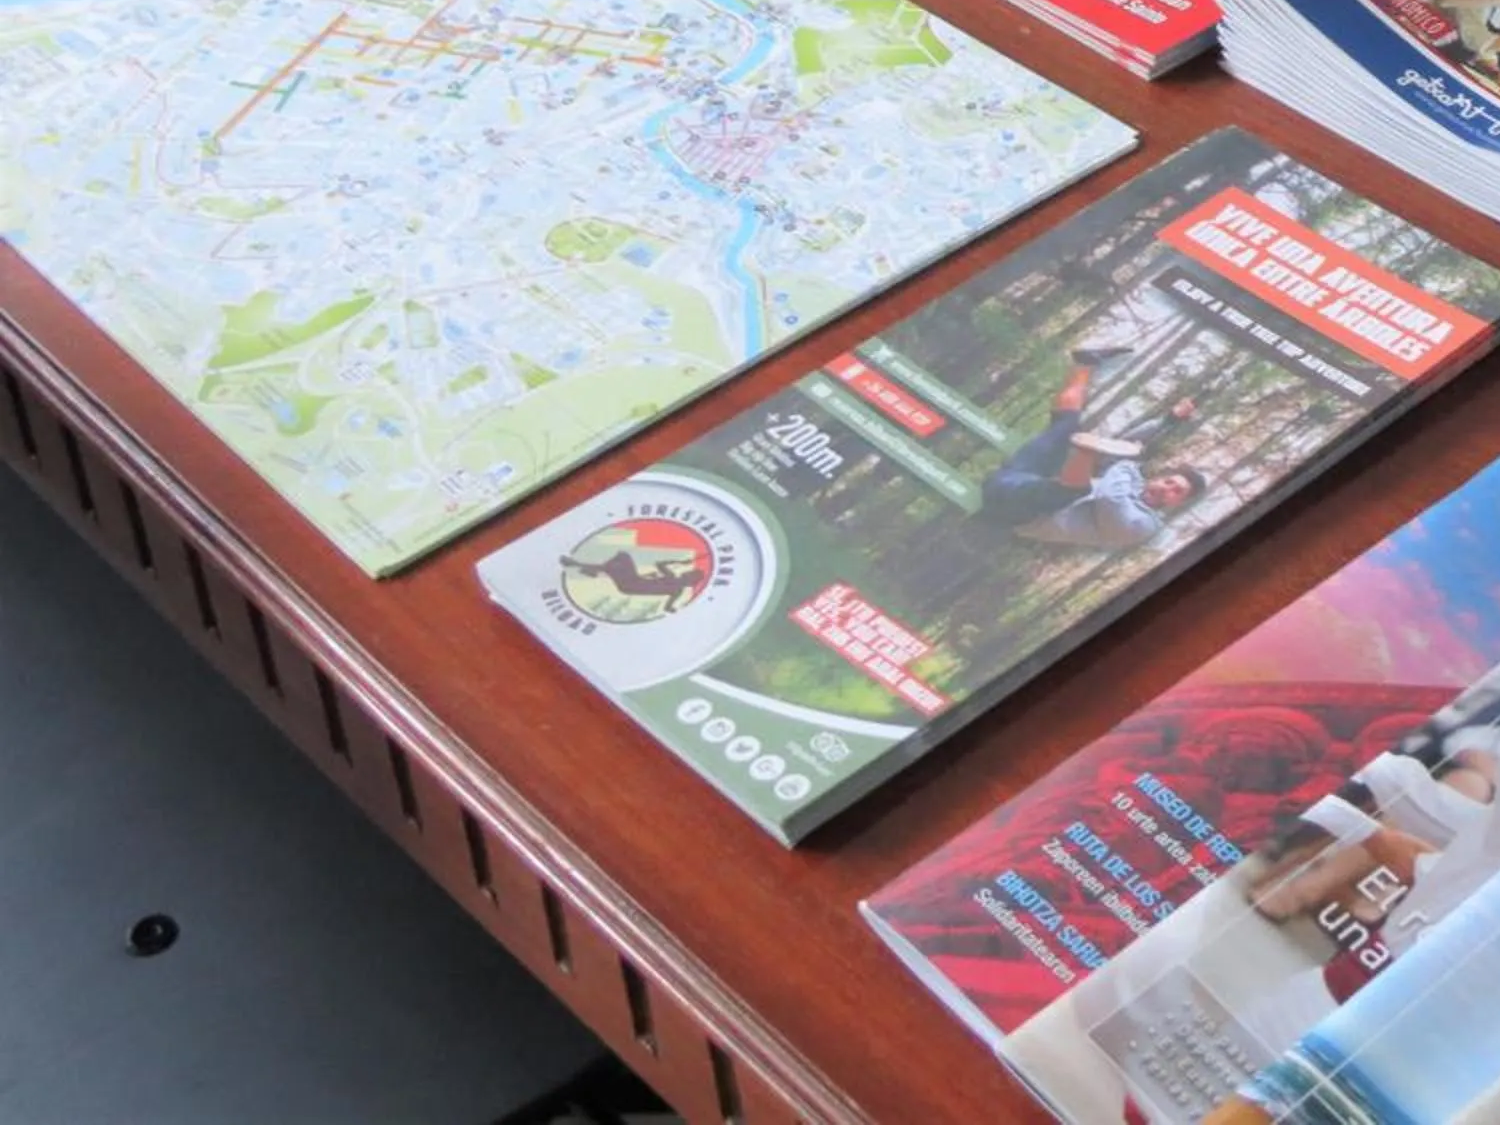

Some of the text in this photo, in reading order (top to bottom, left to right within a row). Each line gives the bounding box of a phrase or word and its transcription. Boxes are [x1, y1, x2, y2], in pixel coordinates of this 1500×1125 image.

[1213, 202, 1455, 345] VIVE UNA AVENTURA
[1250, 258, 1331, 308] ENTRE
[1111, 791, 1133, 810] 10
[1133, 772, 1191, 821] MUSEO
[1184, 816, 1213, 839] DE
[1063, 822, 1109, 861] RUTA
[1102, 854, 1133, 880] DE
[1124, 874, 1161, 906] LOS
[1355, 865, 1408, 912] El
[995, 869, 1063, 932] BIHOTZA
[1317, 901, 1391, 970] una
